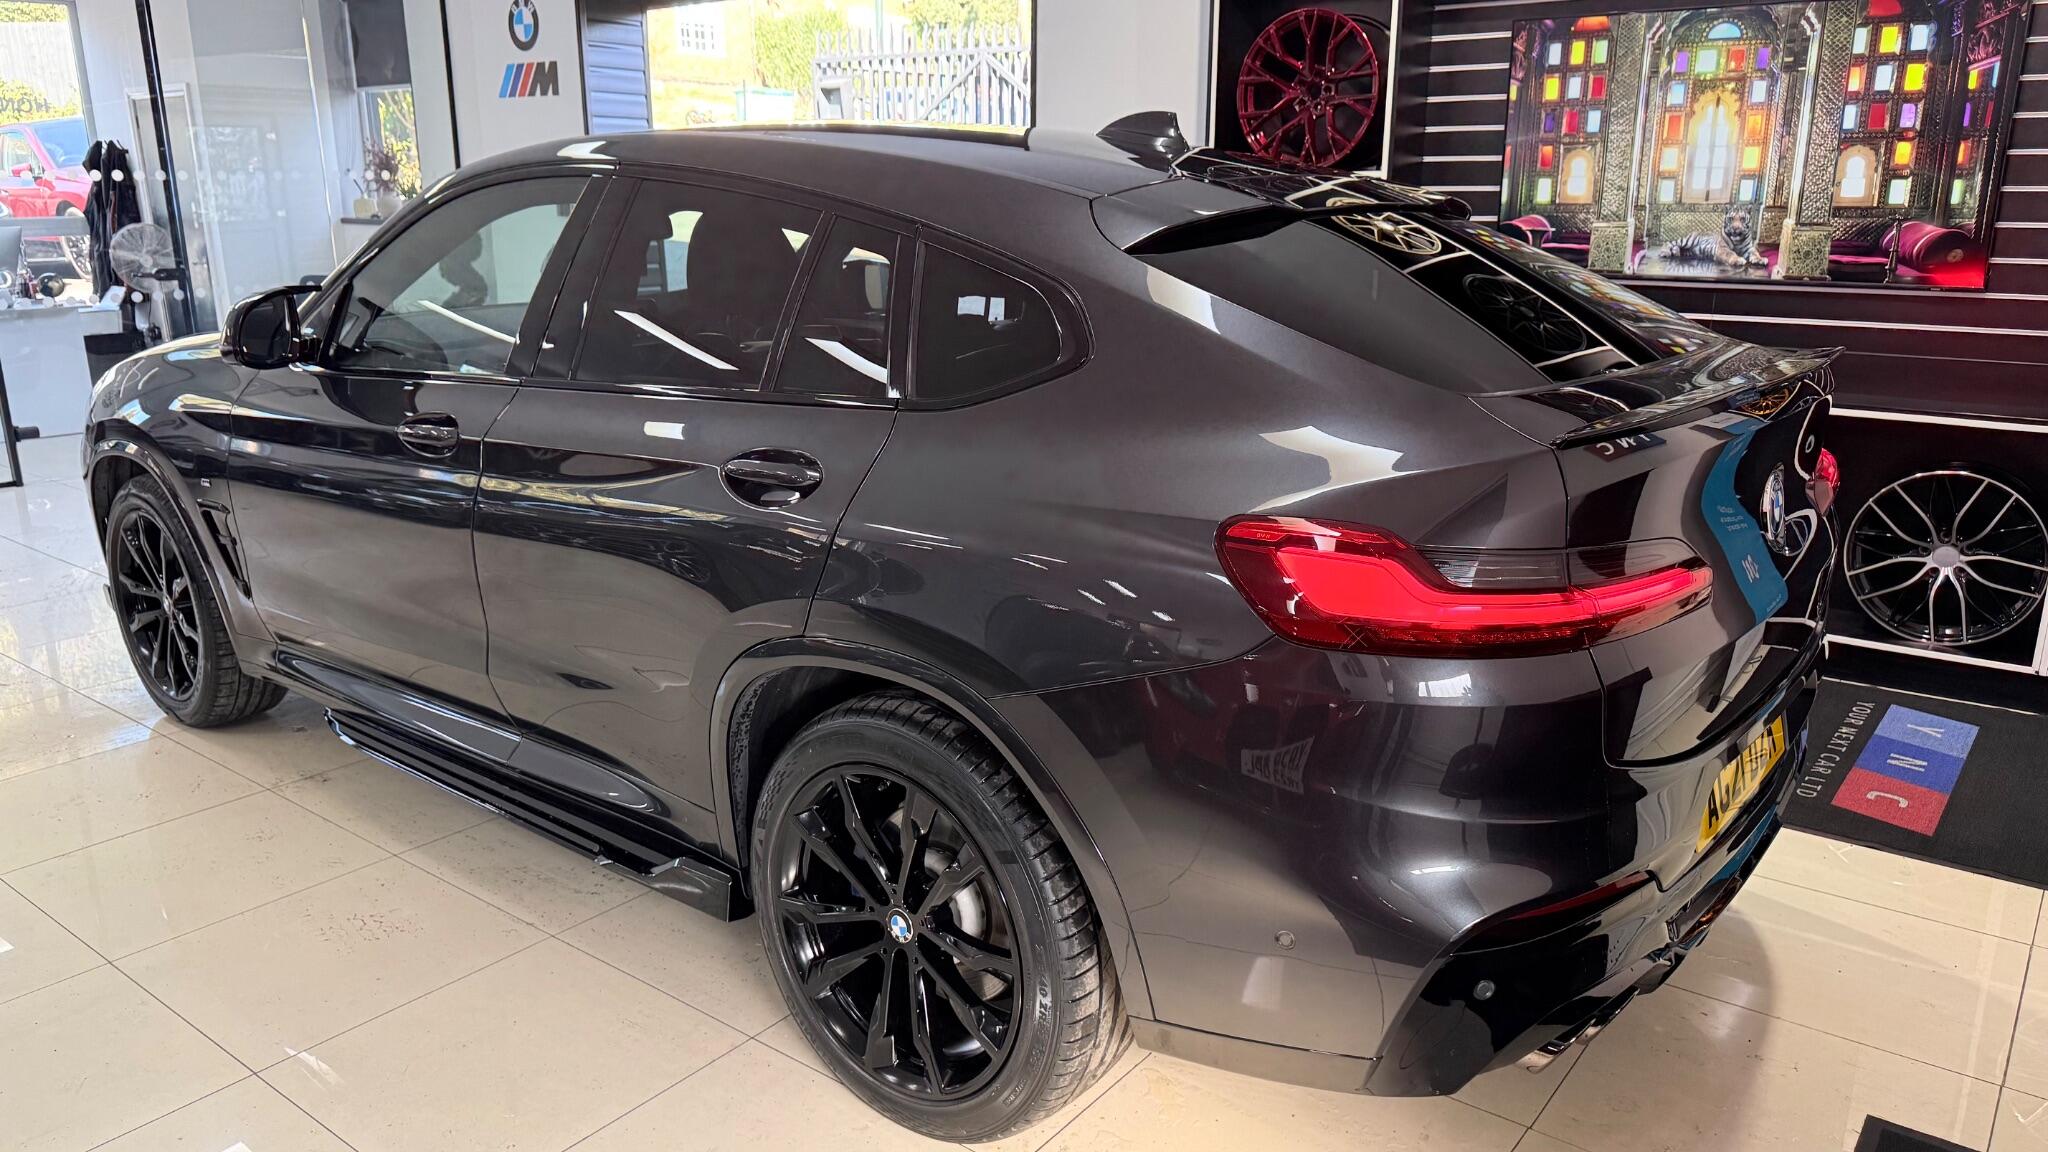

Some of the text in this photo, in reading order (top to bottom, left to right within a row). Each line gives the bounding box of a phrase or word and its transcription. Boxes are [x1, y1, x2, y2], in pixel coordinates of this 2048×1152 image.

[1796, 701, 1876, 798] YOUR NEXT CAR LTD
